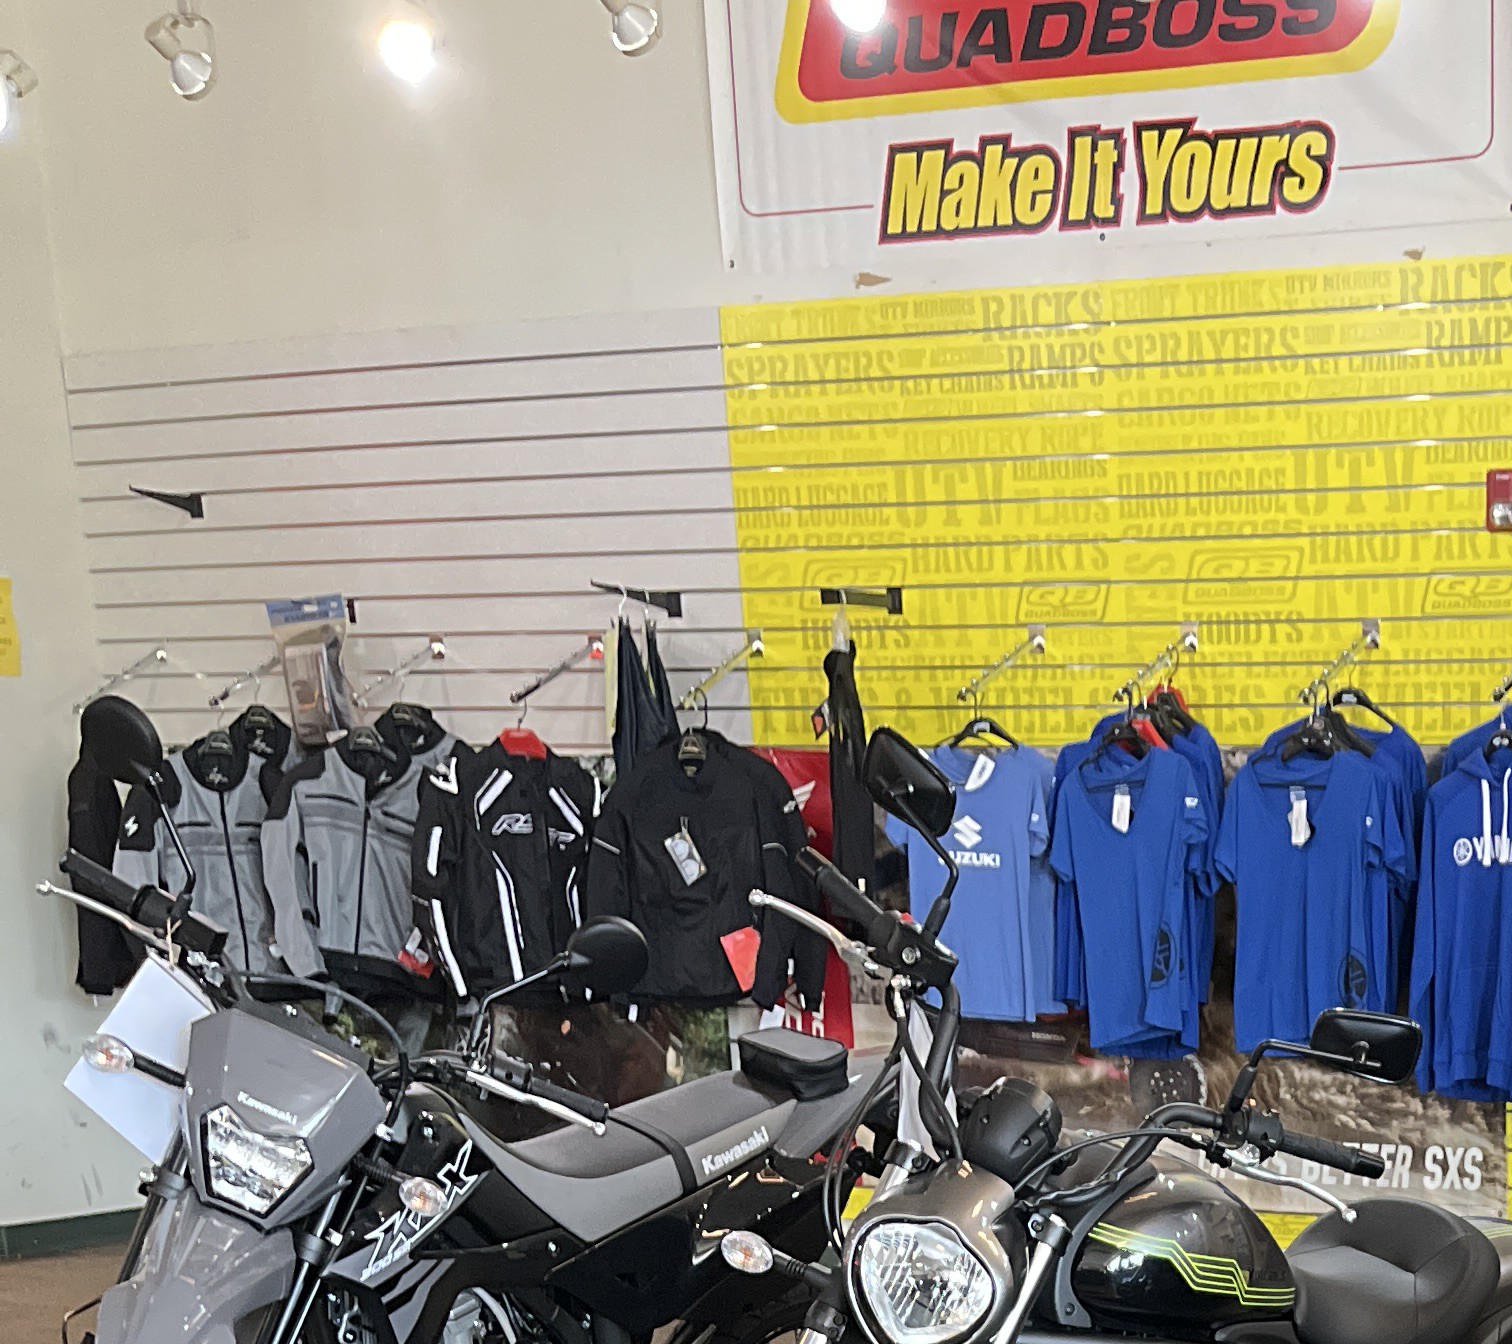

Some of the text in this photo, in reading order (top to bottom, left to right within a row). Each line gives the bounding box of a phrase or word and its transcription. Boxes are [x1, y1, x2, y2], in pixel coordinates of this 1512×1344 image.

[840, 0, 1343, 80] QUADBOSS
[880, 118, 1335, 243] Make It Yours
[982, 290, 1102, 341] RACKS
[726, 350, 894, 400] SPRAYERS
[1008, 340, 1104, 391] RAMPS
[1113, 325, 1300, 382] SPRAYERS
[1304, 352, 1420, 375] KEY CHAINS
[899, 376, 936, 397] KEY
[1117, 382, 1216, 428] CARGO
[1224, 380, 1301, 424] NETS
[1306, 406, 1448, 442] RECOVERY
[796, 482, 890, 529] LUGGAGE
[894, 462, 1007, 528] UTV
[1184, 466, 1287, 516] LUGGAGE
[1291, 447, 1415, 515] UTV
[911, 531, 1110, 574] HARD PARTS
[1309, 522, 1400, 564] HARD
[701, 1125, 770, 1177] Kawasaki
[1423, 1144, 1484, 1192] SXS
[364, 1139, 479, 1272] KX
